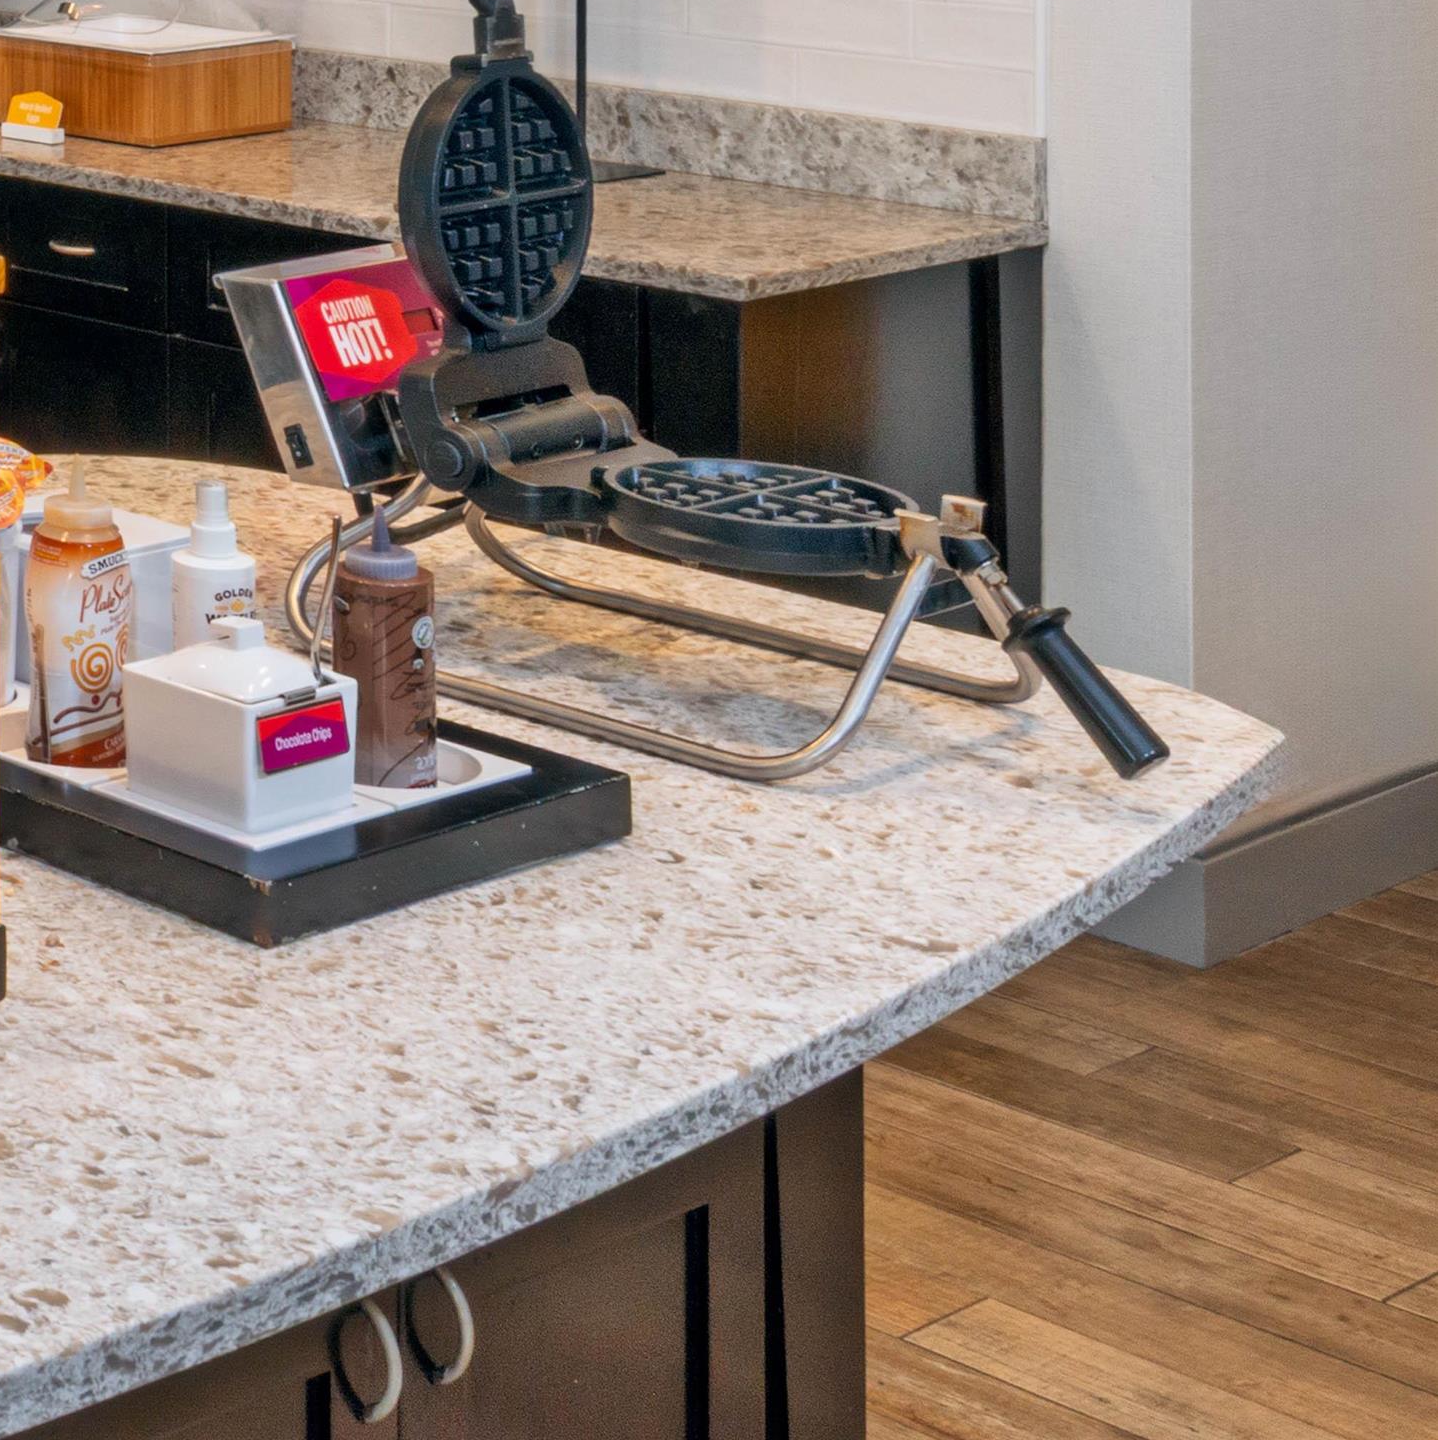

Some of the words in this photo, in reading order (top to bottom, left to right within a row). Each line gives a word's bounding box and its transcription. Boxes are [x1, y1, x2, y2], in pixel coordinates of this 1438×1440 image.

[320, 295, 376, 324] CAUTION
[329, 318, 393, 367] HOT!
[275, 732, 312, 751] Chocolate
[312, 727, 332, 742] Chips
